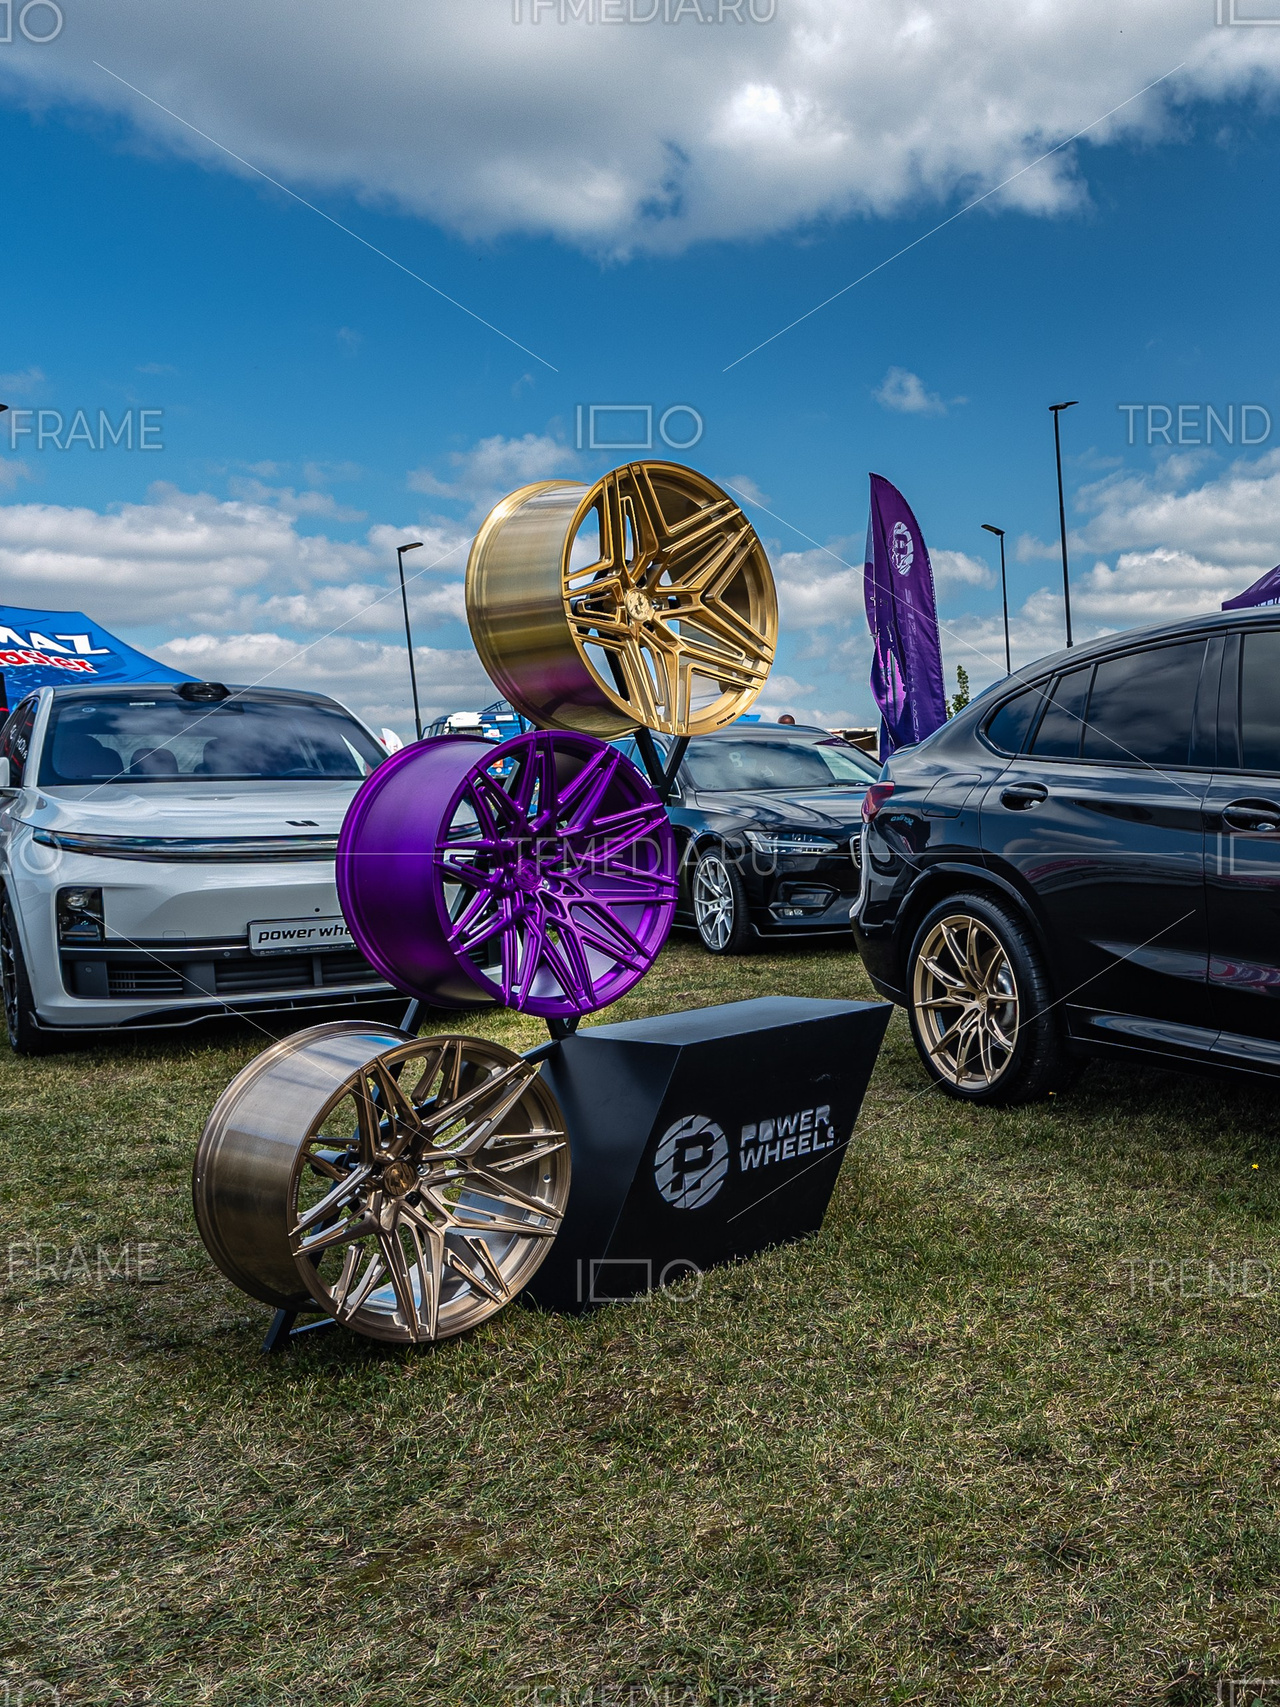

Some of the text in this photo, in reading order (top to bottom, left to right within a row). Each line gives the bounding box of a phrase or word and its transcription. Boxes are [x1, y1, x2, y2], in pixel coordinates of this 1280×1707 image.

[258, 927, 316, 944] power
[740, 1104, 831, 1148] POWER
[739, 1126, 841, 1172] WHEELS
